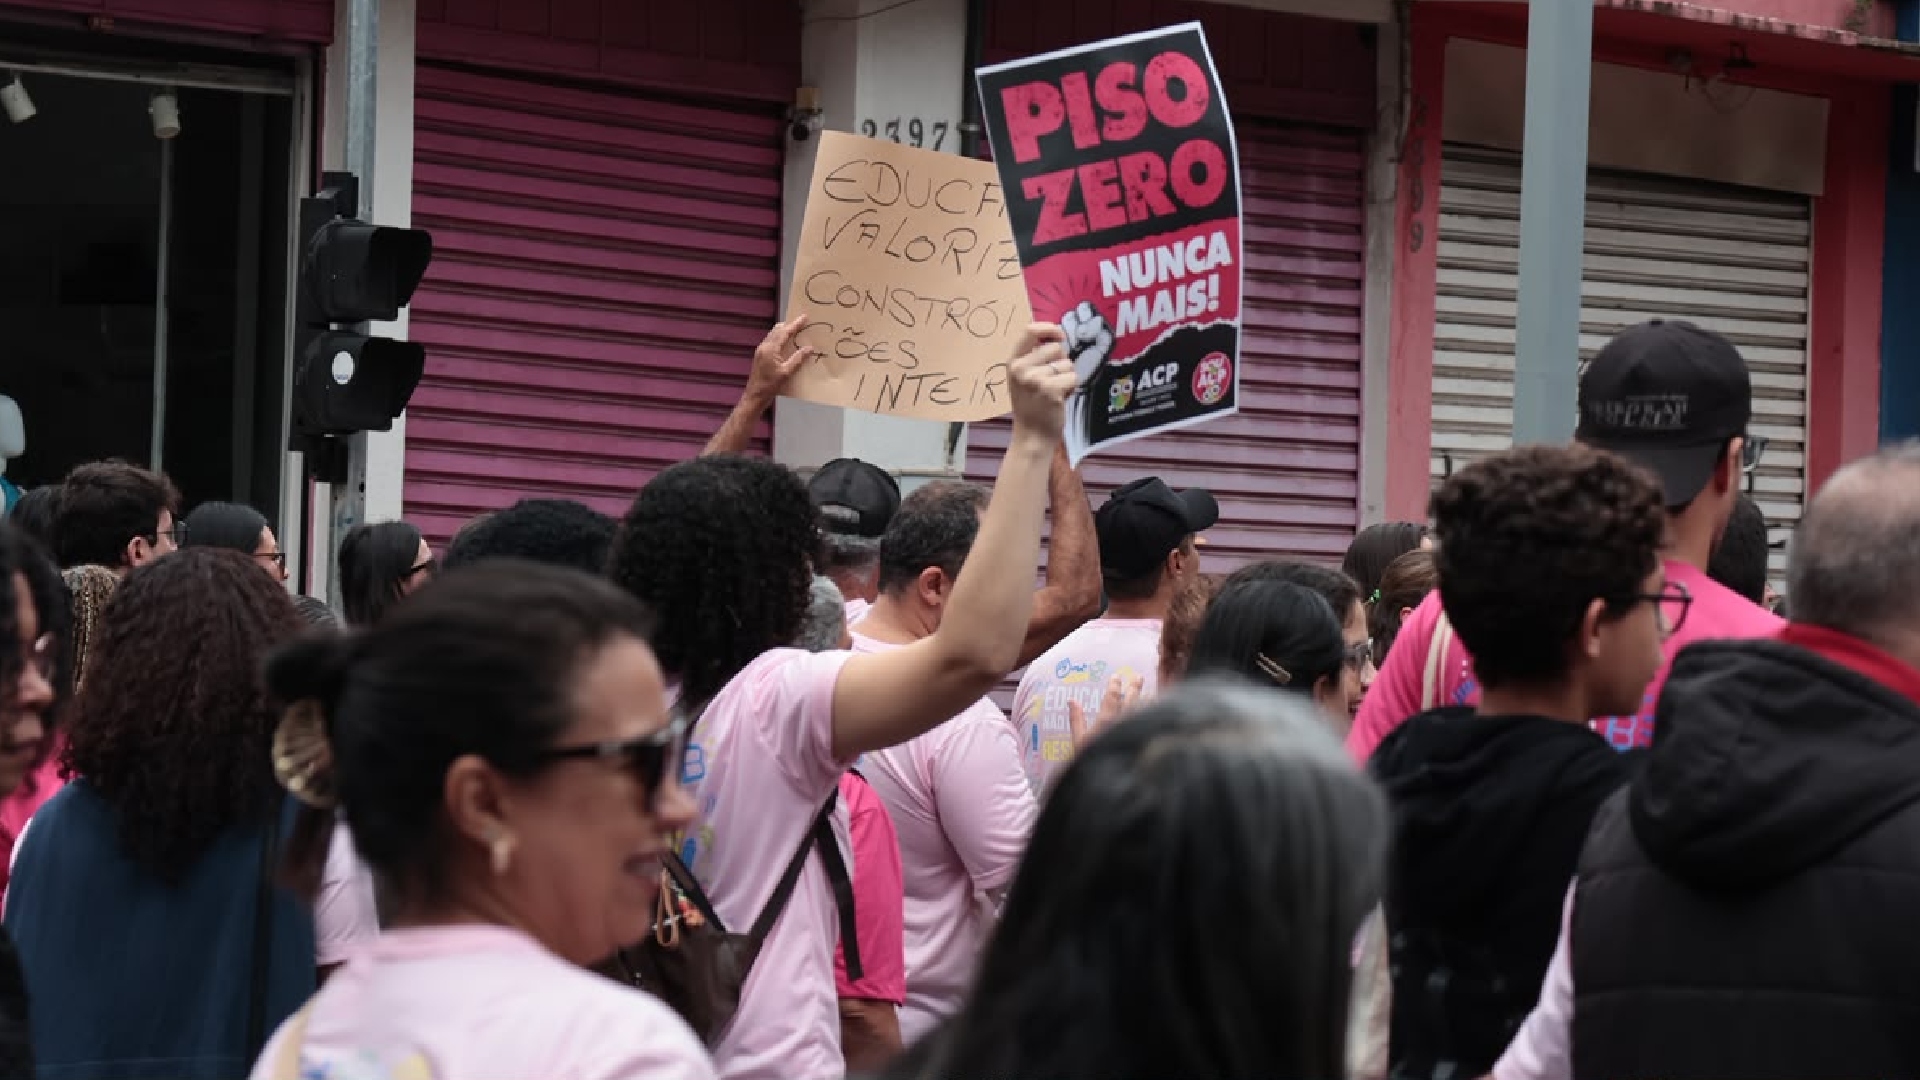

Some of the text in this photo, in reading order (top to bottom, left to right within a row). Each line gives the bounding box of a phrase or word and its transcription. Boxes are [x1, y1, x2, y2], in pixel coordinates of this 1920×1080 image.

[1001, 51, 1210, 164] PISO
[1020, 139, 1227, 246] ZERO
[1099, 231, 1233, 297] NUNCA
[804, 270, 1017, 338] CONSTRÓI
[1116, 273, 1221, 338] MAIS!
[1137, 362, 1179, 391] ACP
